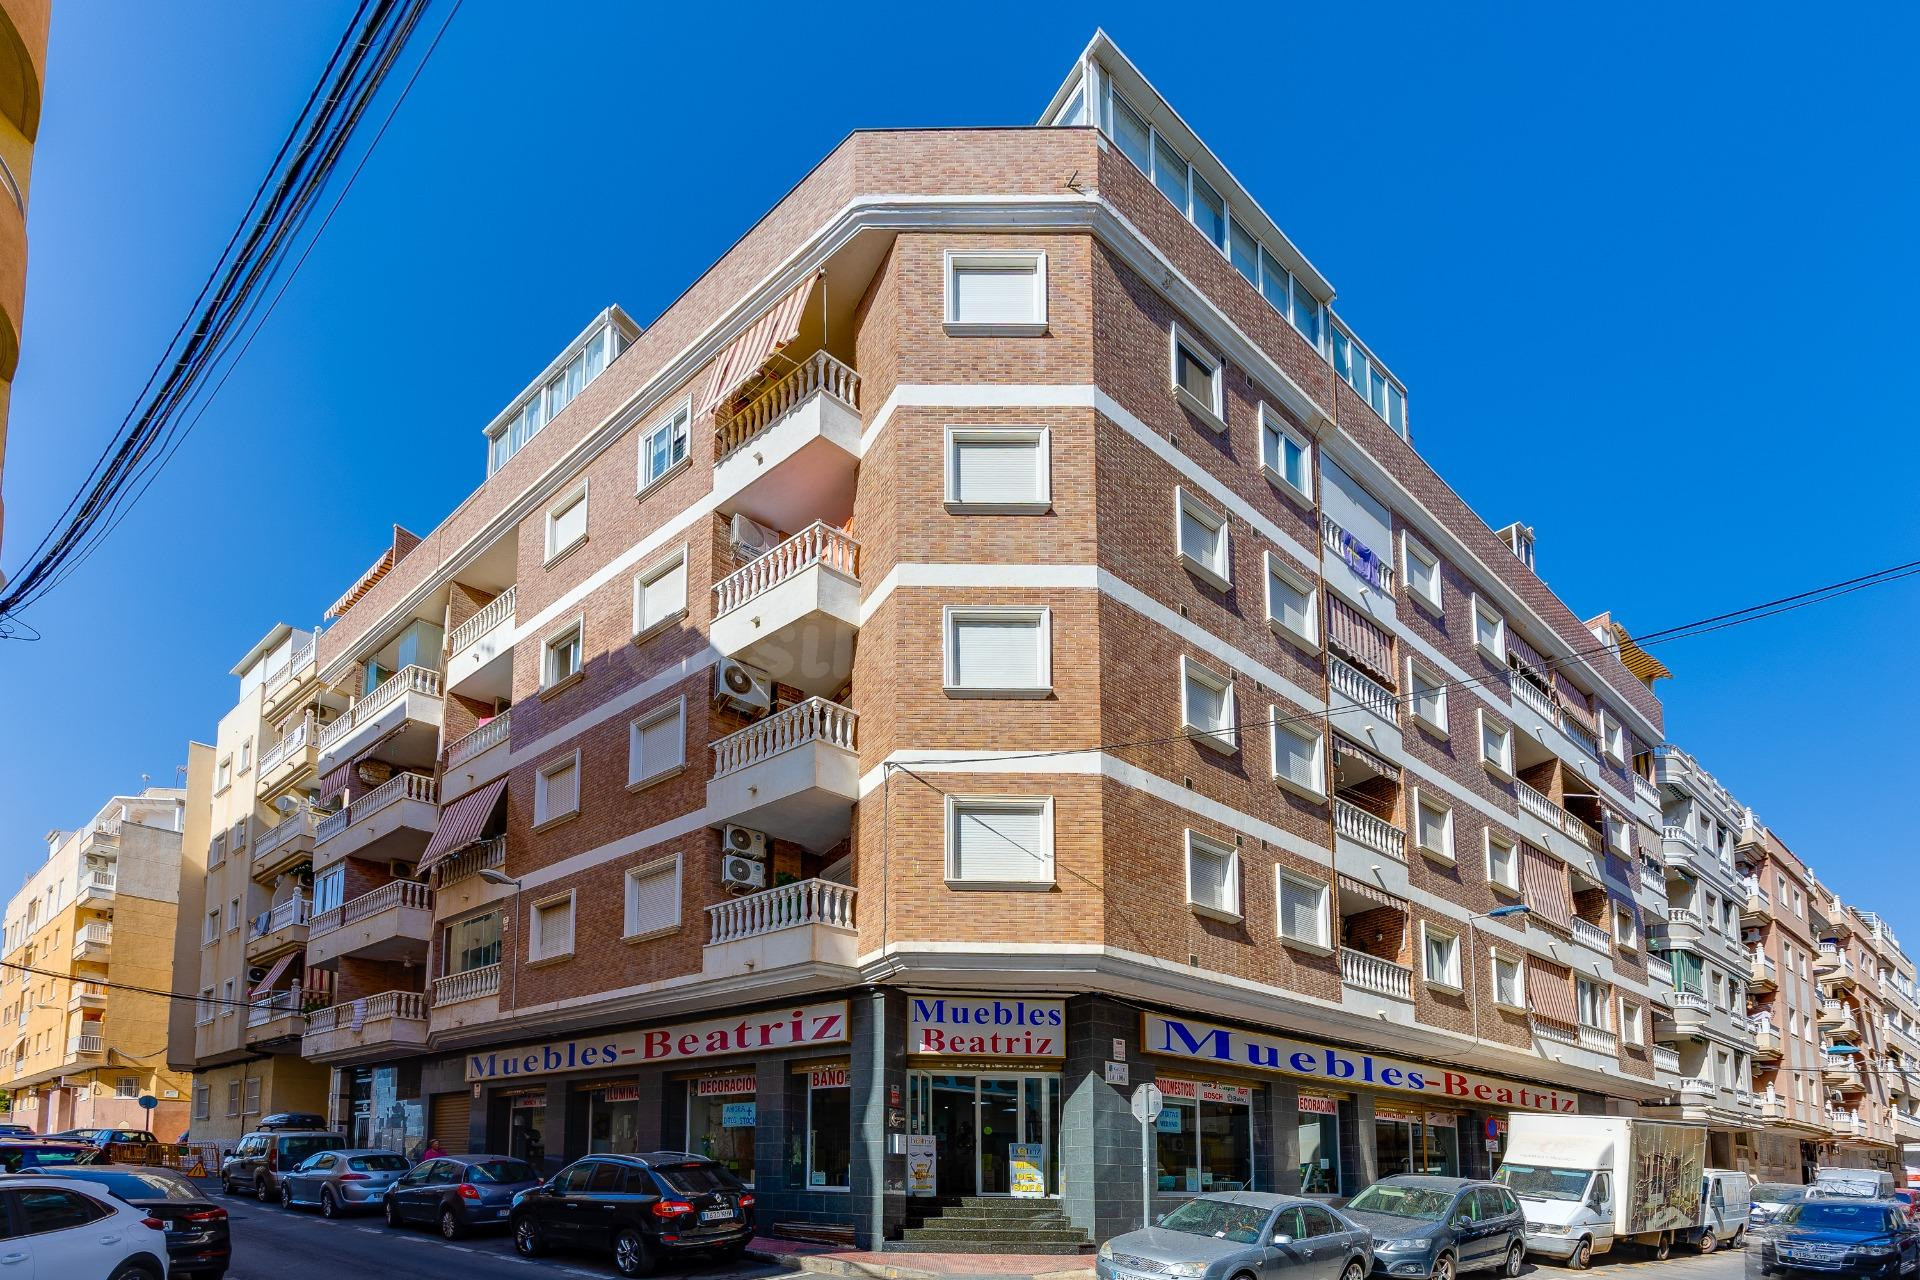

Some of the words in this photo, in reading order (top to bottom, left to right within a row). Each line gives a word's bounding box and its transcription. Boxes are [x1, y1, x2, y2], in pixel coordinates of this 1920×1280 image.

[912, 999, 1062, 1026] Muebles
[469, 1010, 842, 1079] Muebles-Beatriz
[921, 1028, 1053, 1054] Beatriz
[1158, 1019, 1576, 1113] Muebles-Beatriz
[1203, 1091, 1223, 1100] BOSCH
